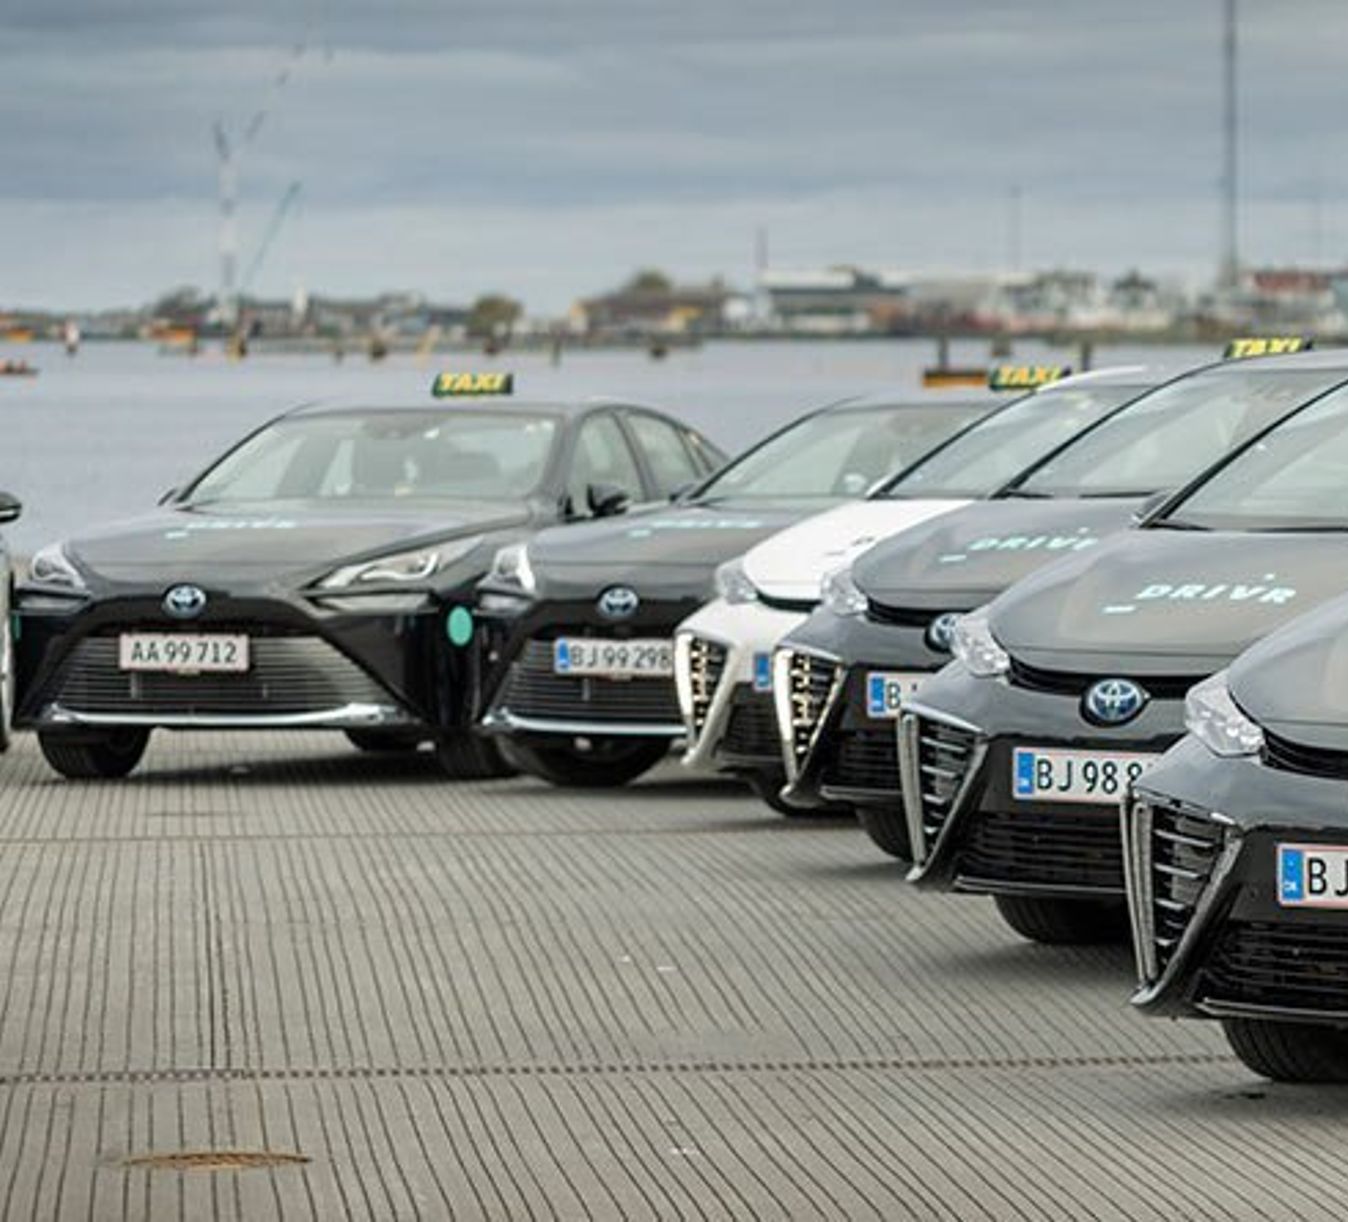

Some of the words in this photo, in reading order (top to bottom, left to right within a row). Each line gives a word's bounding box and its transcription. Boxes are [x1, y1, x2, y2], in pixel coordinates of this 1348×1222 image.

[1230, 337, 1303, 358] TAXI
[441, 373, 504, 392] TAXI
[1000, 366, 1060, 386] TAXI
[1133, 584, 1297, 604] DRIVR
[131, 641, 159, 661] AA
[164, 641, 192, 662] 99
[196, 641, 237, 663] 712
[602, 645, 630, 667] 99
[1036, 758, 1073, 792] BJ
[1082, 760, 1118, 795] 98
